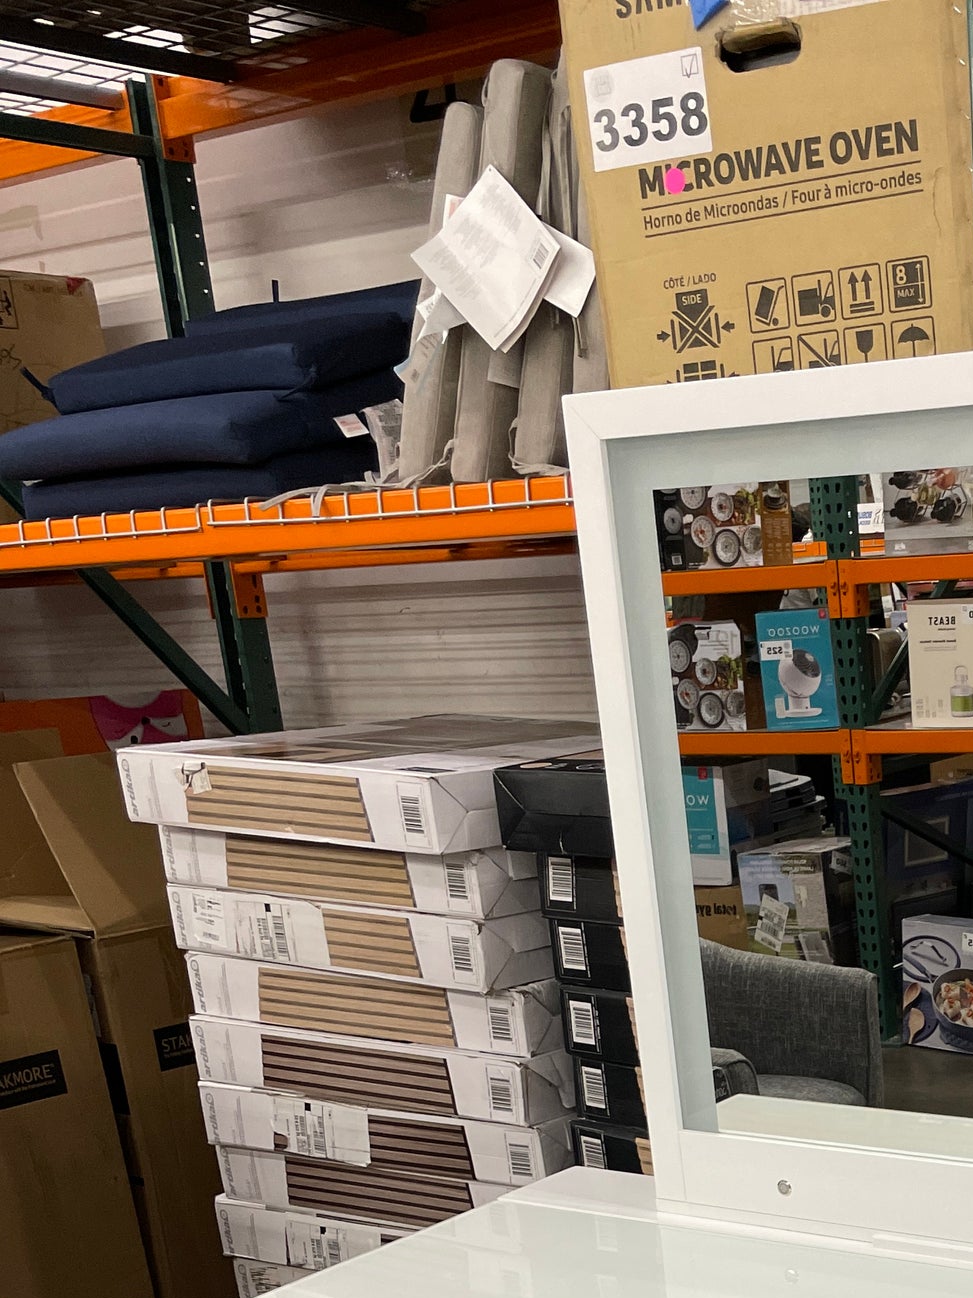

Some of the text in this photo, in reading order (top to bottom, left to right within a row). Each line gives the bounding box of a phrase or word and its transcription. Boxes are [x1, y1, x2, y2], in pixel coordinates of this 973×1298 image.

[593, 92, 709, 152] 3358
[829, 119, 920, 163] OVEN
[643, 211, 682, 231] Horno
[685, 207, 700, 223] de
[703, 194, 779, 220] Microondas
[791, 189, 820, 206] Four
[823, 182, 831, 199] à
[835, 170, 922, 197] micro-ondes
[663, 275, 687, 290] CÔTÉ
[692, 273, 717, 285] LADO
[894, 265, 907, 285] 8
[681, 294, 703, 306] SIDE
[897, 287, 916, 299] MAX
